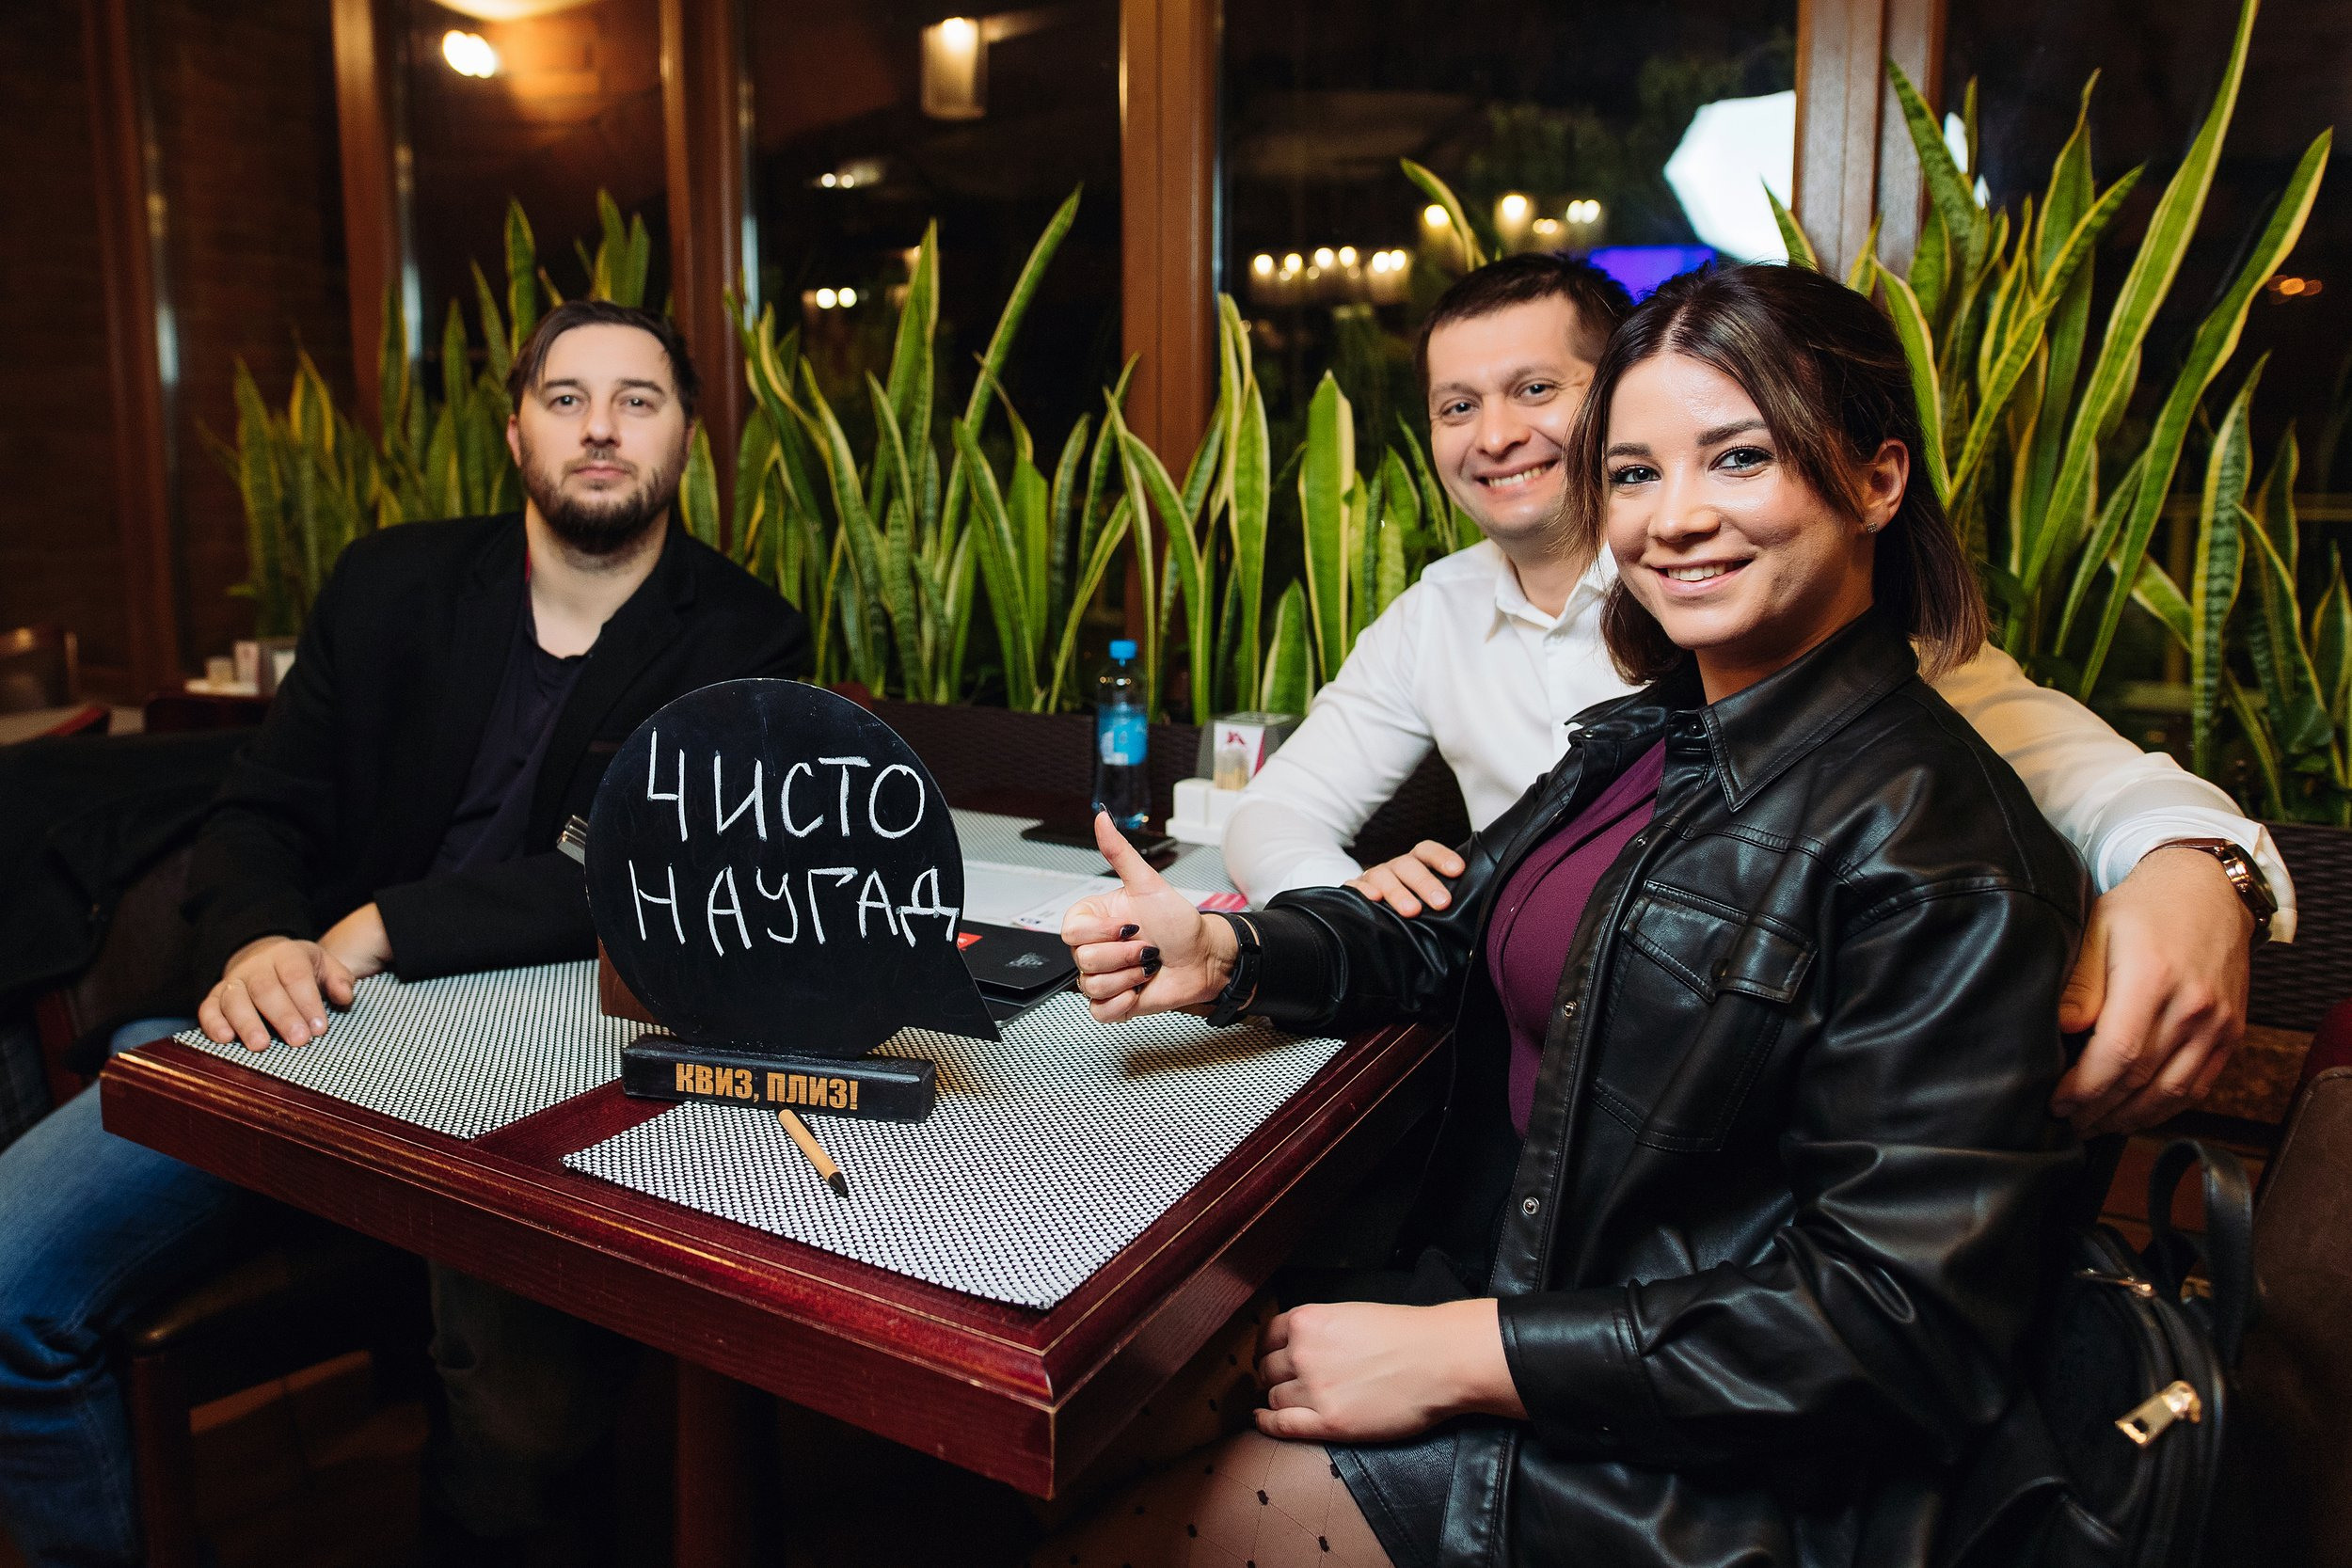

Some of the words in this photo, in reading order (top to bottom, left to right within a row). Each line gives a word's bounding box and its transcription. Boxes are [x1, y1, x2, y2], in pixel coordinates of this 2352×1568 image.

[646, 729, 926, 842] ЧИСТО
[628, 860, 959, 958] НАУГАД
[675, 1062, 760, 1103] КВИЗ,
[766, 1071, 859, 1111] ПЛИЗ!
